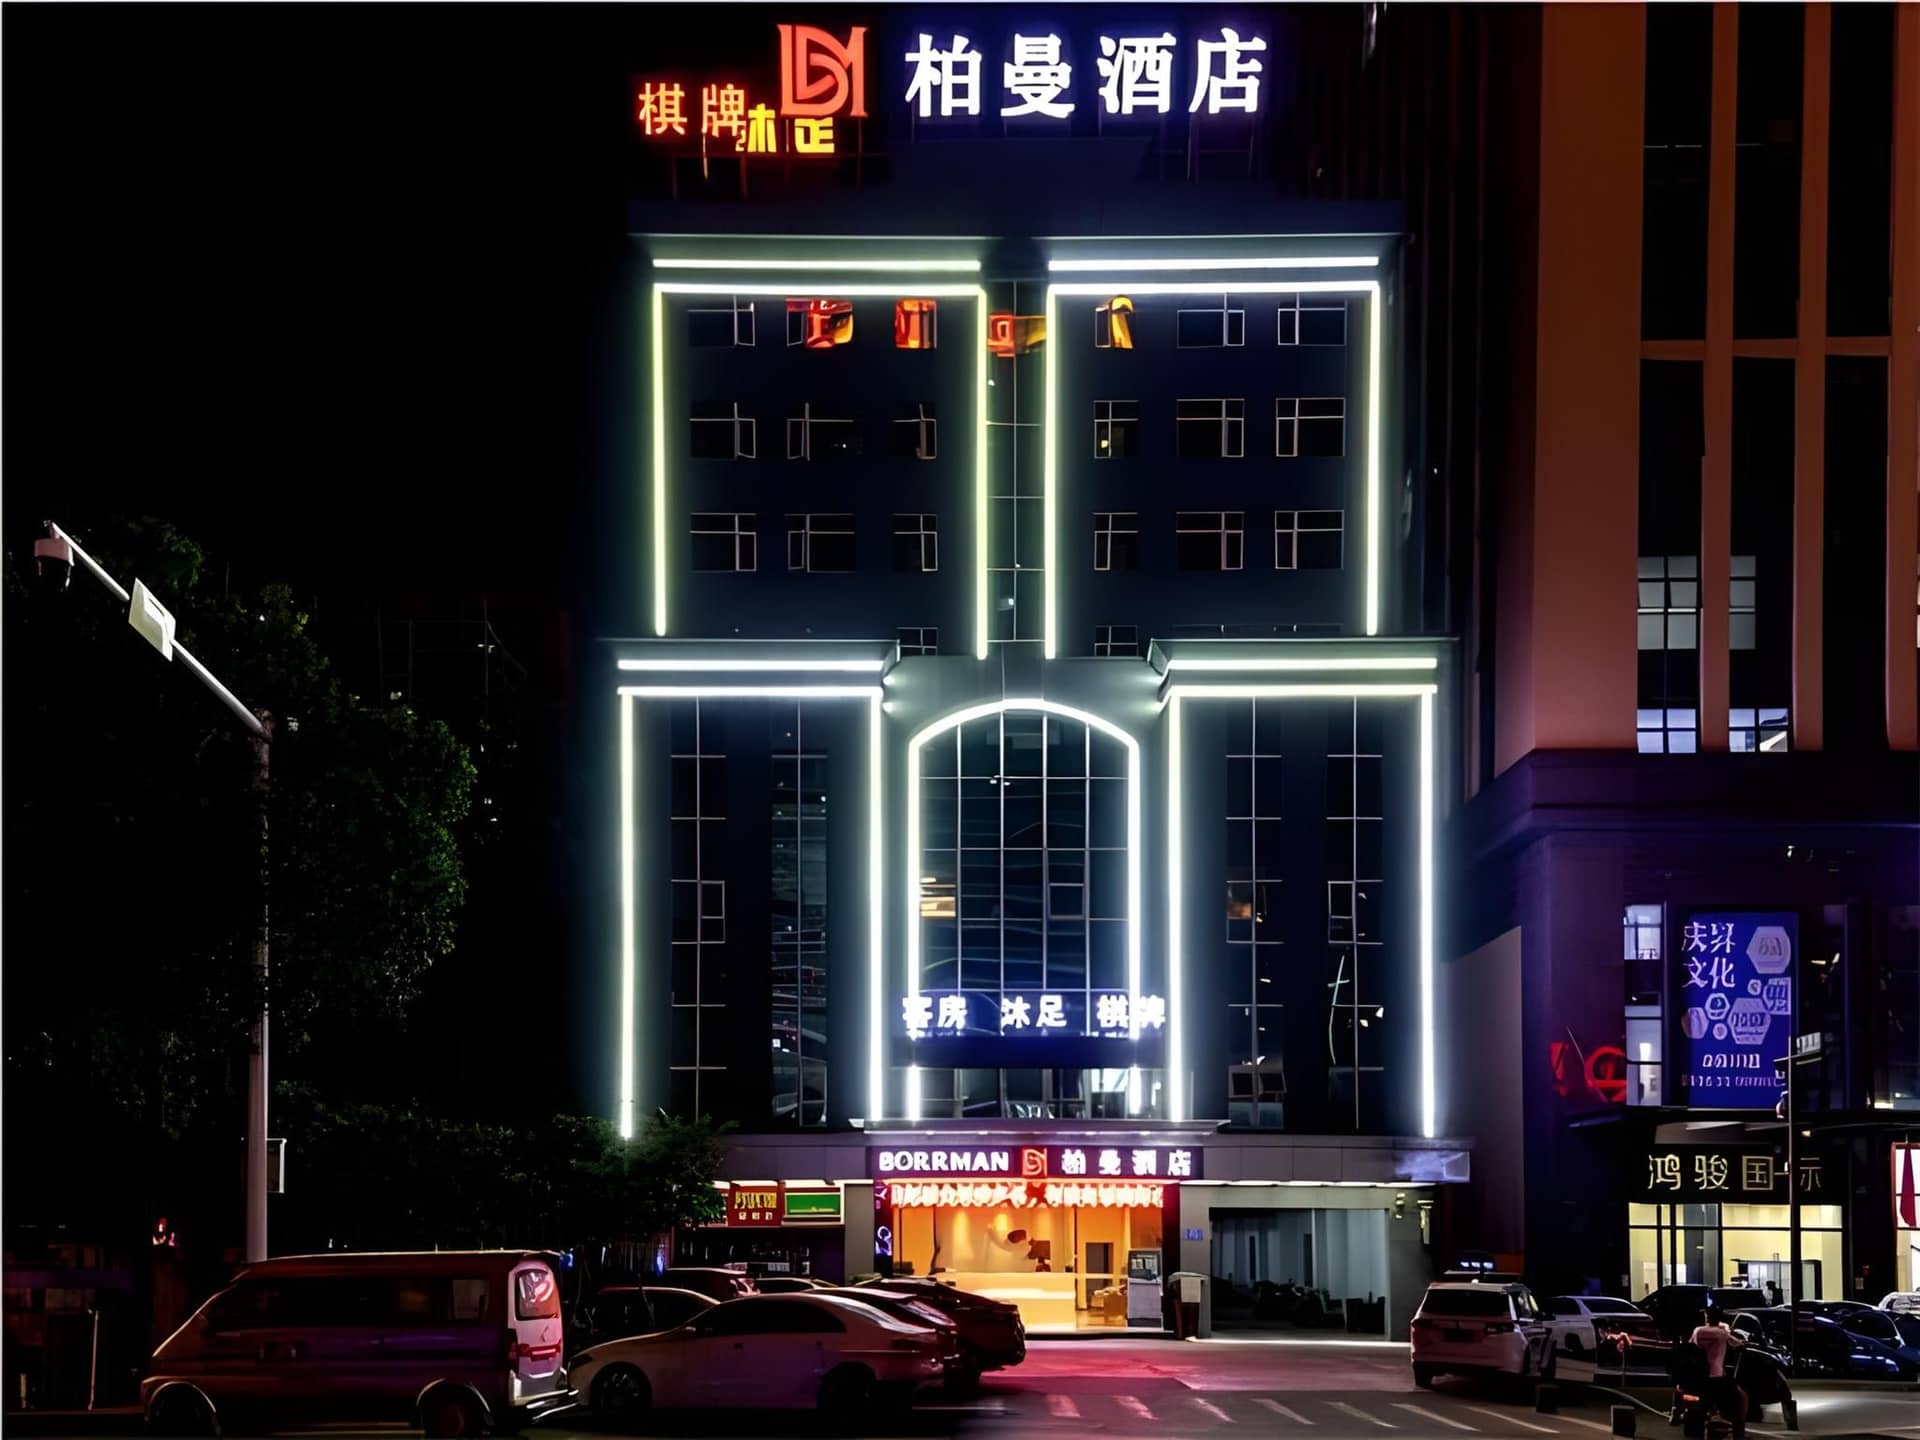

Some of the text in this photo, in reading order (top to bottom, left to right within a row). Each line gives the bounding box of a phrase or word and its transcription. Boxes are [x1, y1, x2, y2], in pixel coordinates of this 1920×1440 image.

[904, 28, 1267, 119] 柏曼酒店
[638, 83, 747, 138] 棋牌
[1682, 956, 1736, 989] 文化
[1001, 994, 1067, 1029] 沐足
[878, 1150, 1009, 1172] BORRMAN
